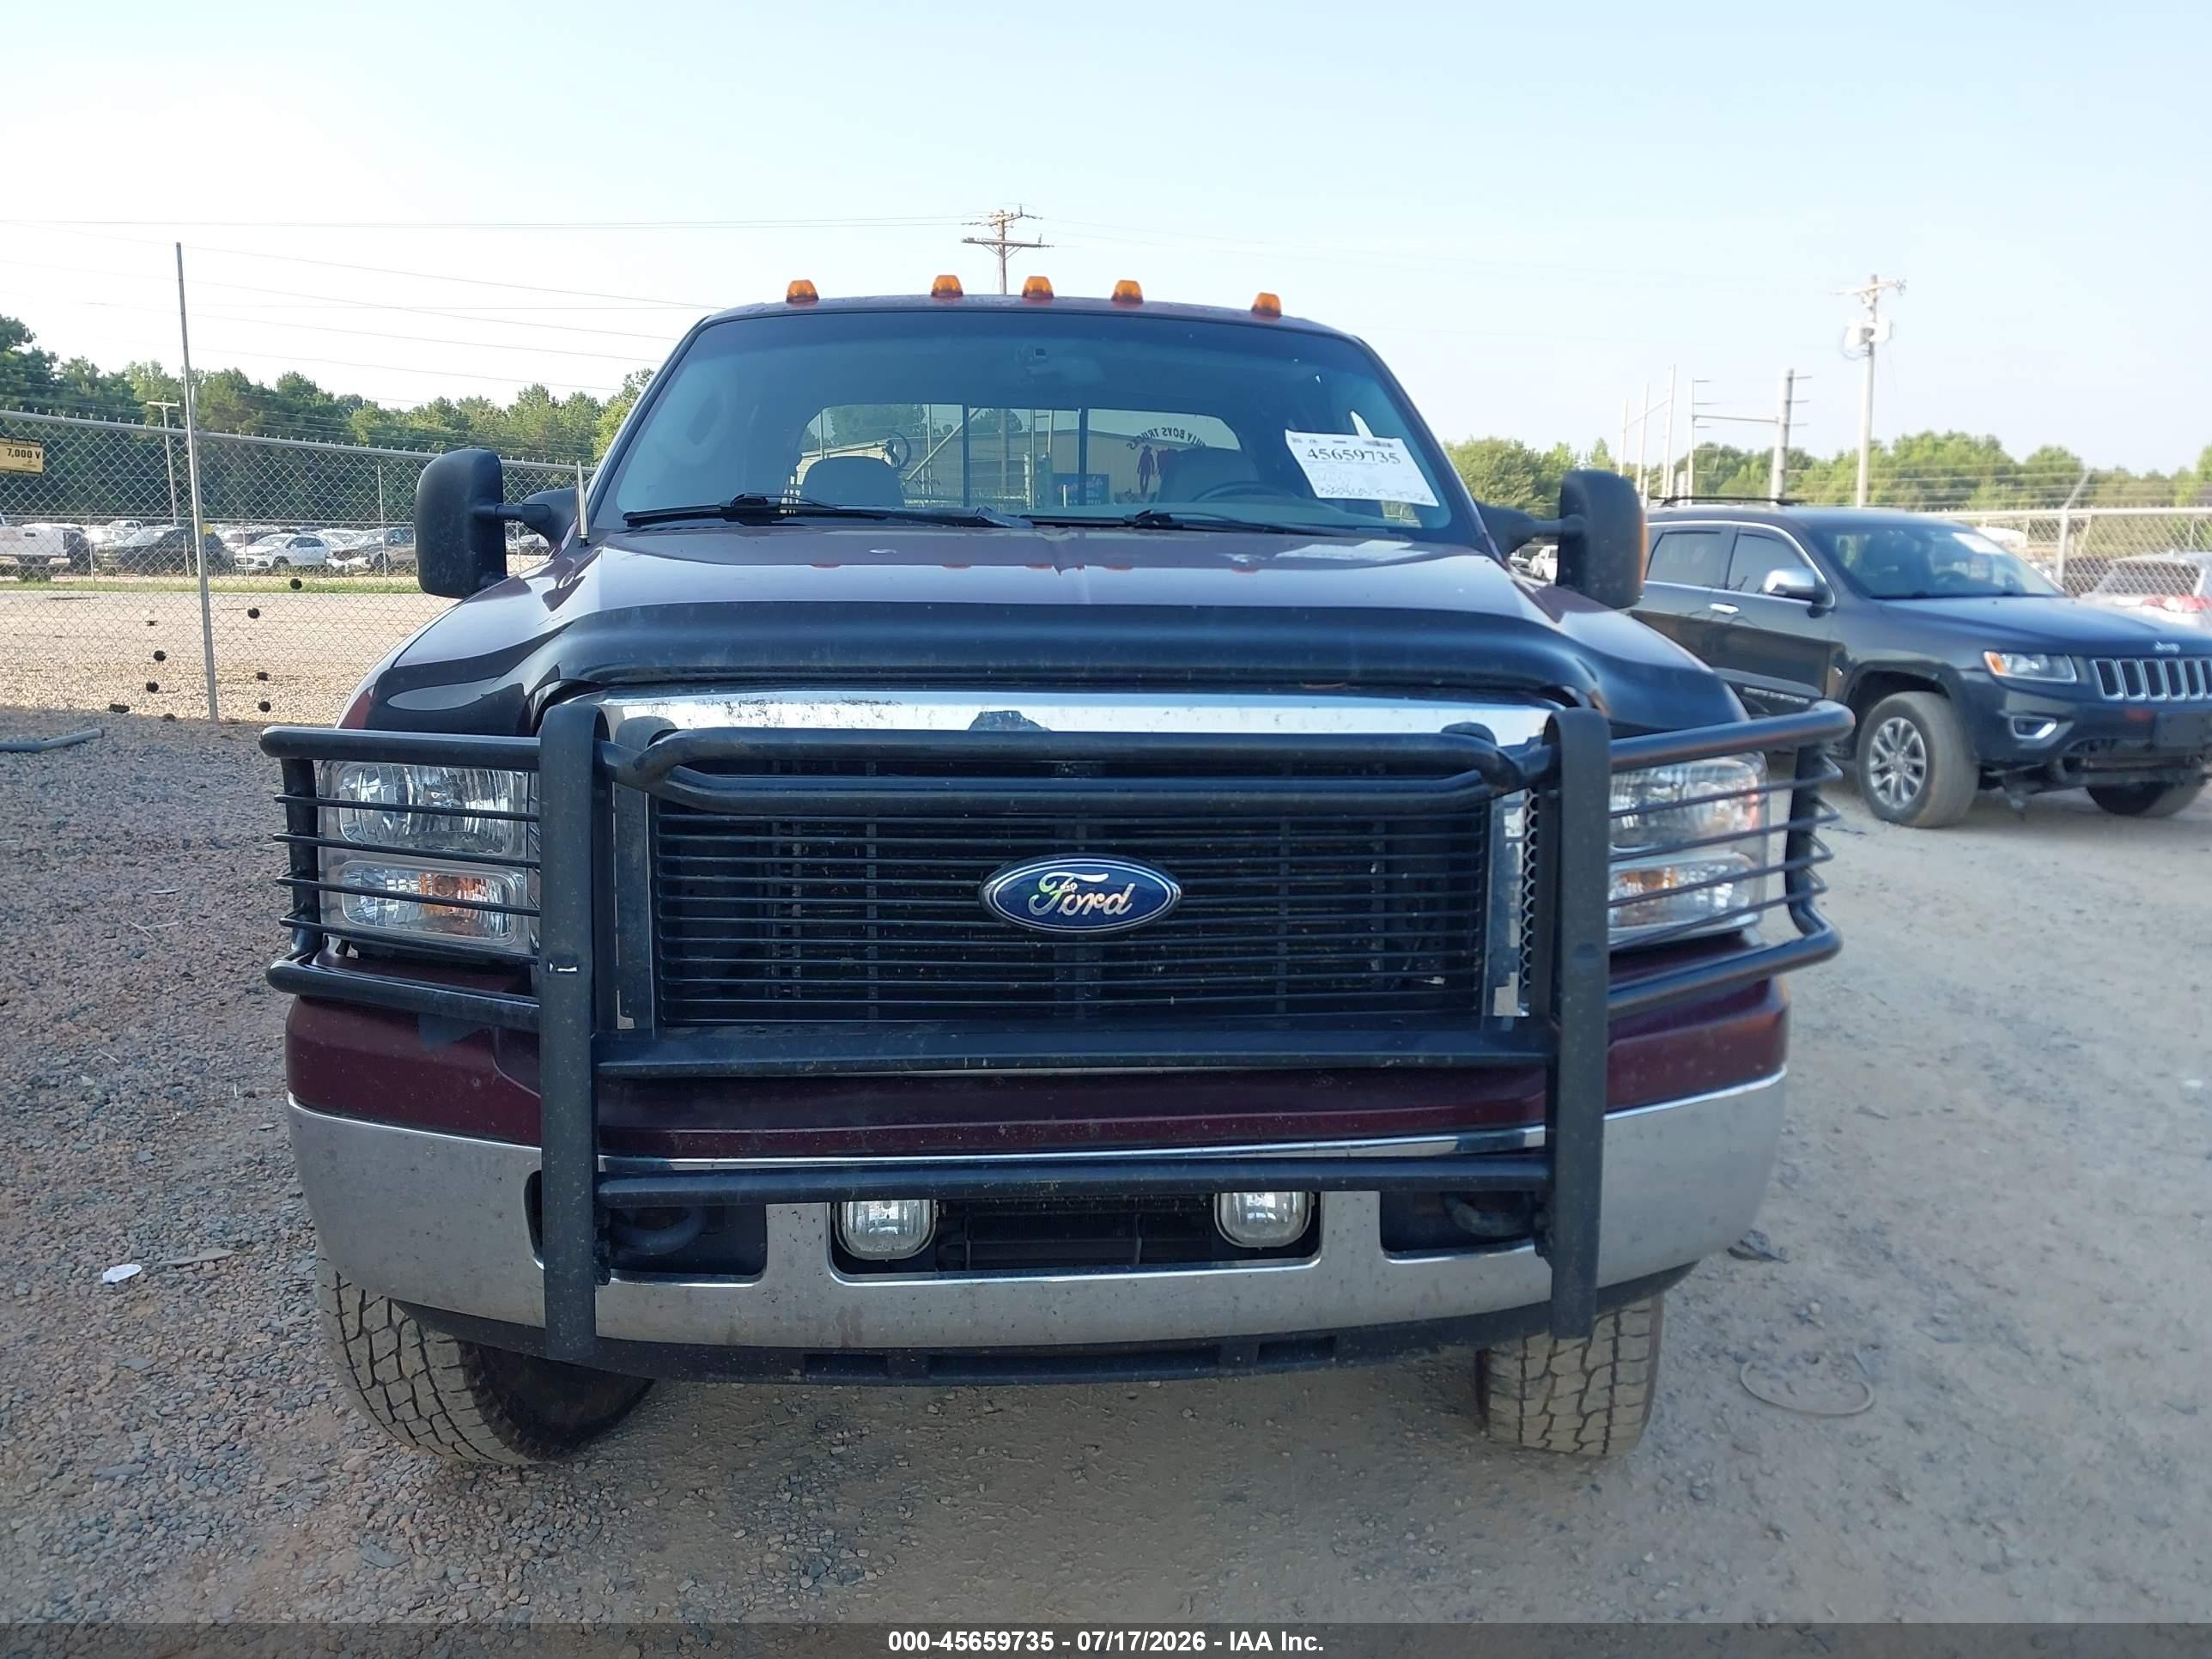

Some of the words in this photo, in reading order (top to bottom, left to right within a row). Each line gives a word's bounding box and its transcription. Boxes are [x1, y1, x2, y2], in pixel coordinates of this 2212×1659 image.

[6, 447, 33, 459] 7,000
[35, 451, 41, 459] V
[1306, 447, 1401, 465] 45659735
[1028, 872, 1136, 916] Ford
